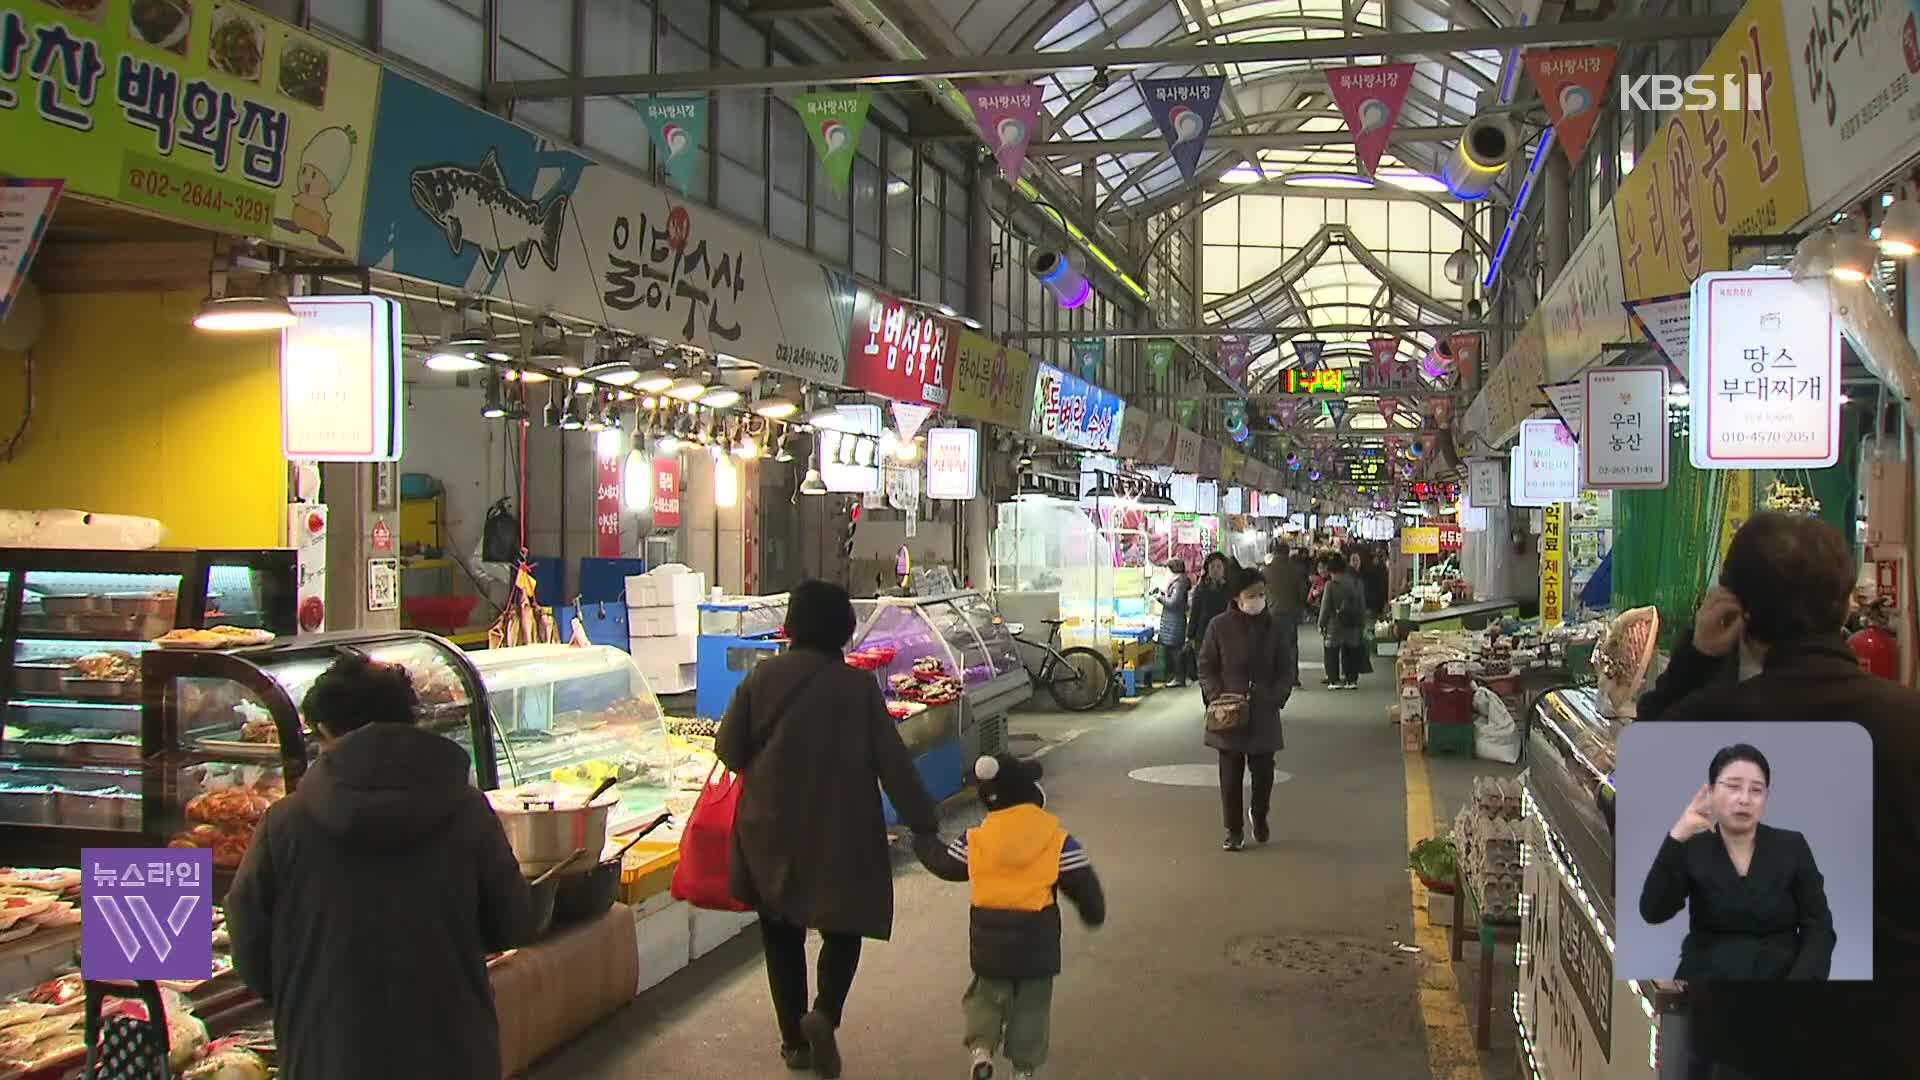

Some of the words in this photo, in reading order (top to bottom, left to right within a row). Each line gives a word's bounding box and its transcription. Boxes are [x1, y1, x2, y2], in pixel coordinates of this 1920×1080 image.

[1539, 56, 1601, 75] 목사랑시장
[1339, 72, 1398, 89] 목사랑시장
[977, 94, 1031, 110] 목사랑시장
[1155, 84, 1212, 101] 목사랑시장
[647, 103, 696, 120] 목사랑시장
[806, 99, 858, 115] 목사랑시장
[117, 53, 290, 188] 백화점
[147, 168, 272, 226] 02-2644-3291
[863, 299, 950, 387] 모범정육점
[1742, 344, 1798, 374] 땅스
[1718, 374, 1823, 403] 부대찌개
[1046, 386, 1087, 441] 돈벼락
[1088, 404, 1112, 448] 수산
[1609, 411, 1642, 430] 우리
[1608, 432, 1643, 453] 농산
[1544, 501, 1560, 552] 약재료
